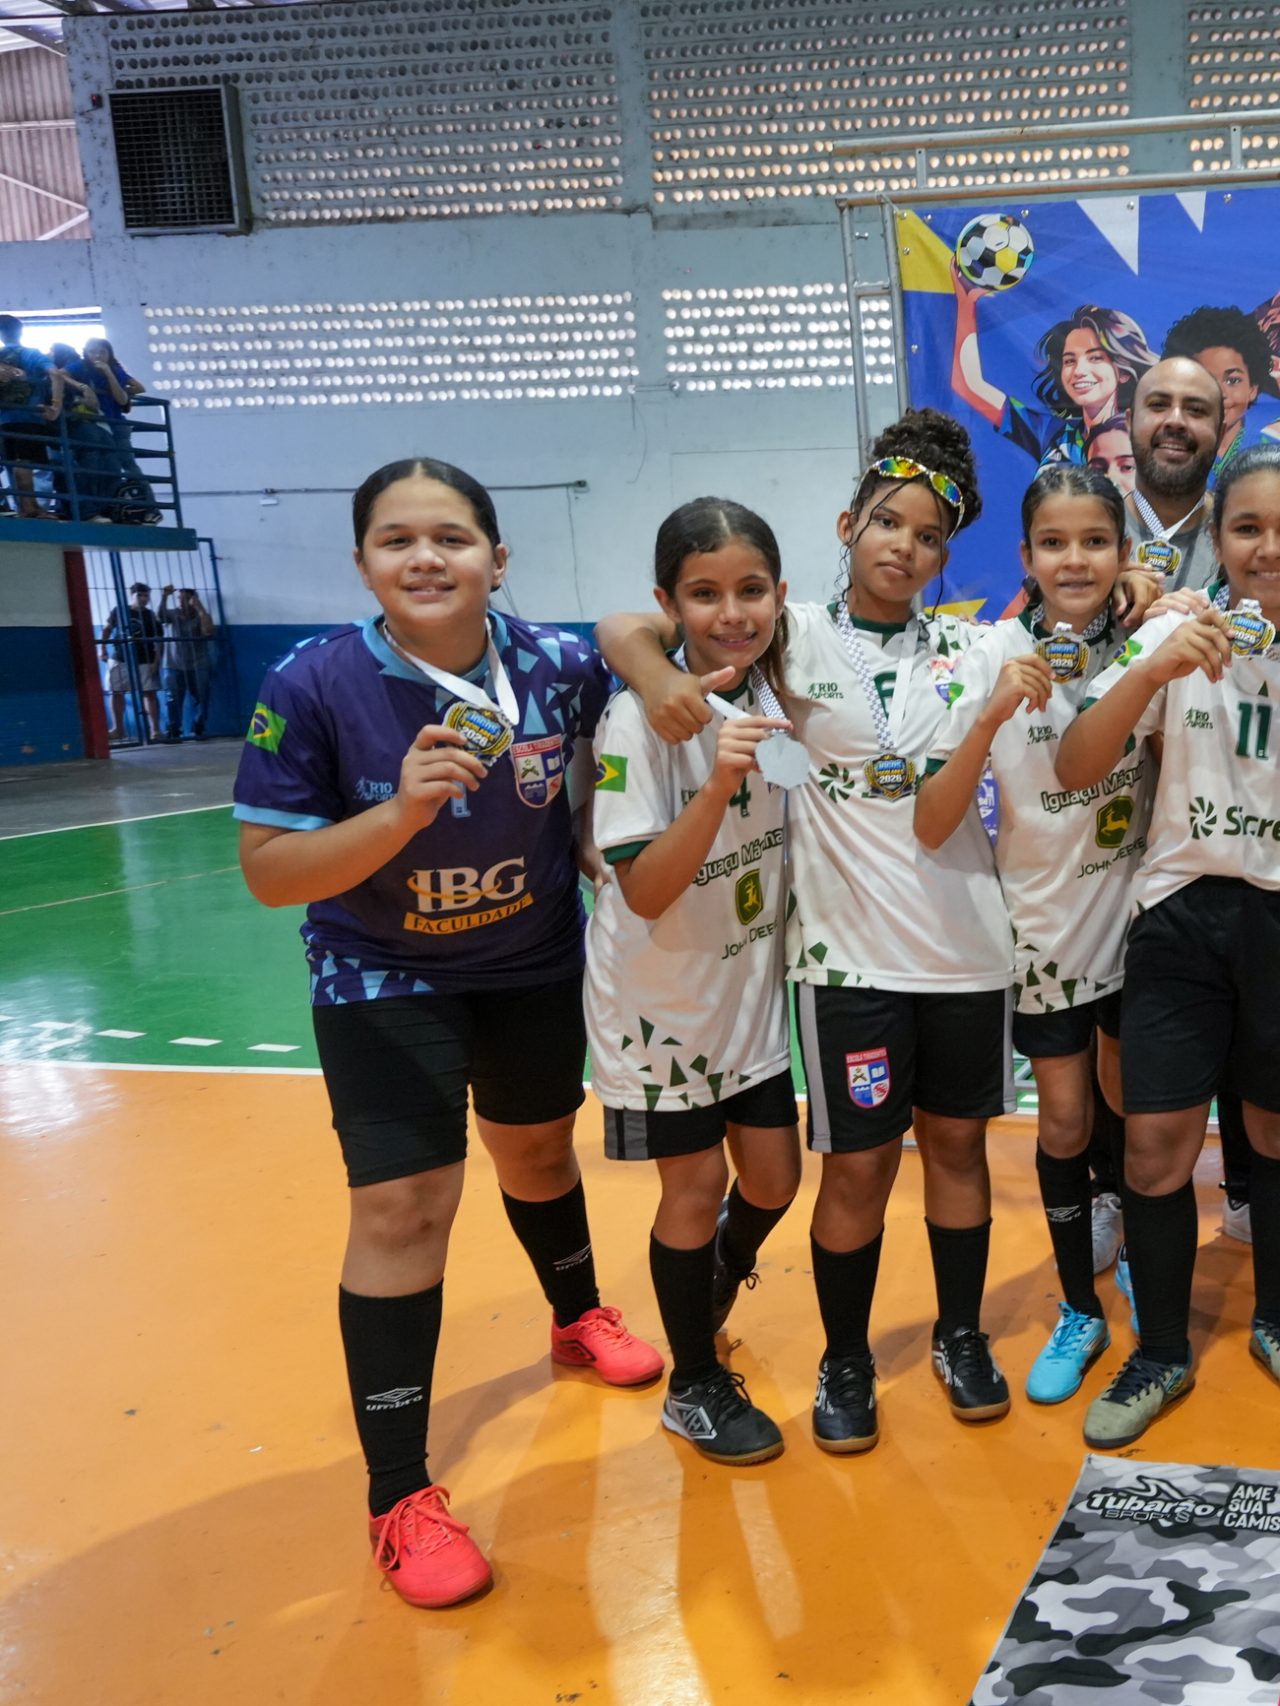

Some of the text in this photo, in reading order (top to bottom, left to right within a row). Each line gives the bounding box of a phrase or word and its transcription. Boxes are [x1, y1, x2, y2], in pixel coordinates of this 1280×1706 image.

[1236, 702, 1272, 761] 11
[369, 782, 393, 794] R10
[692, 850, 739, 887] guaçu
[413, 856, 528, 913] IBG
[412, 896, 528, 934] FACULDADE
[366, 1394, 423, 1411] umbro
[1228, 1498, 1264, 1515] SUA
[1232, 1484, 1275, 1502] AME
